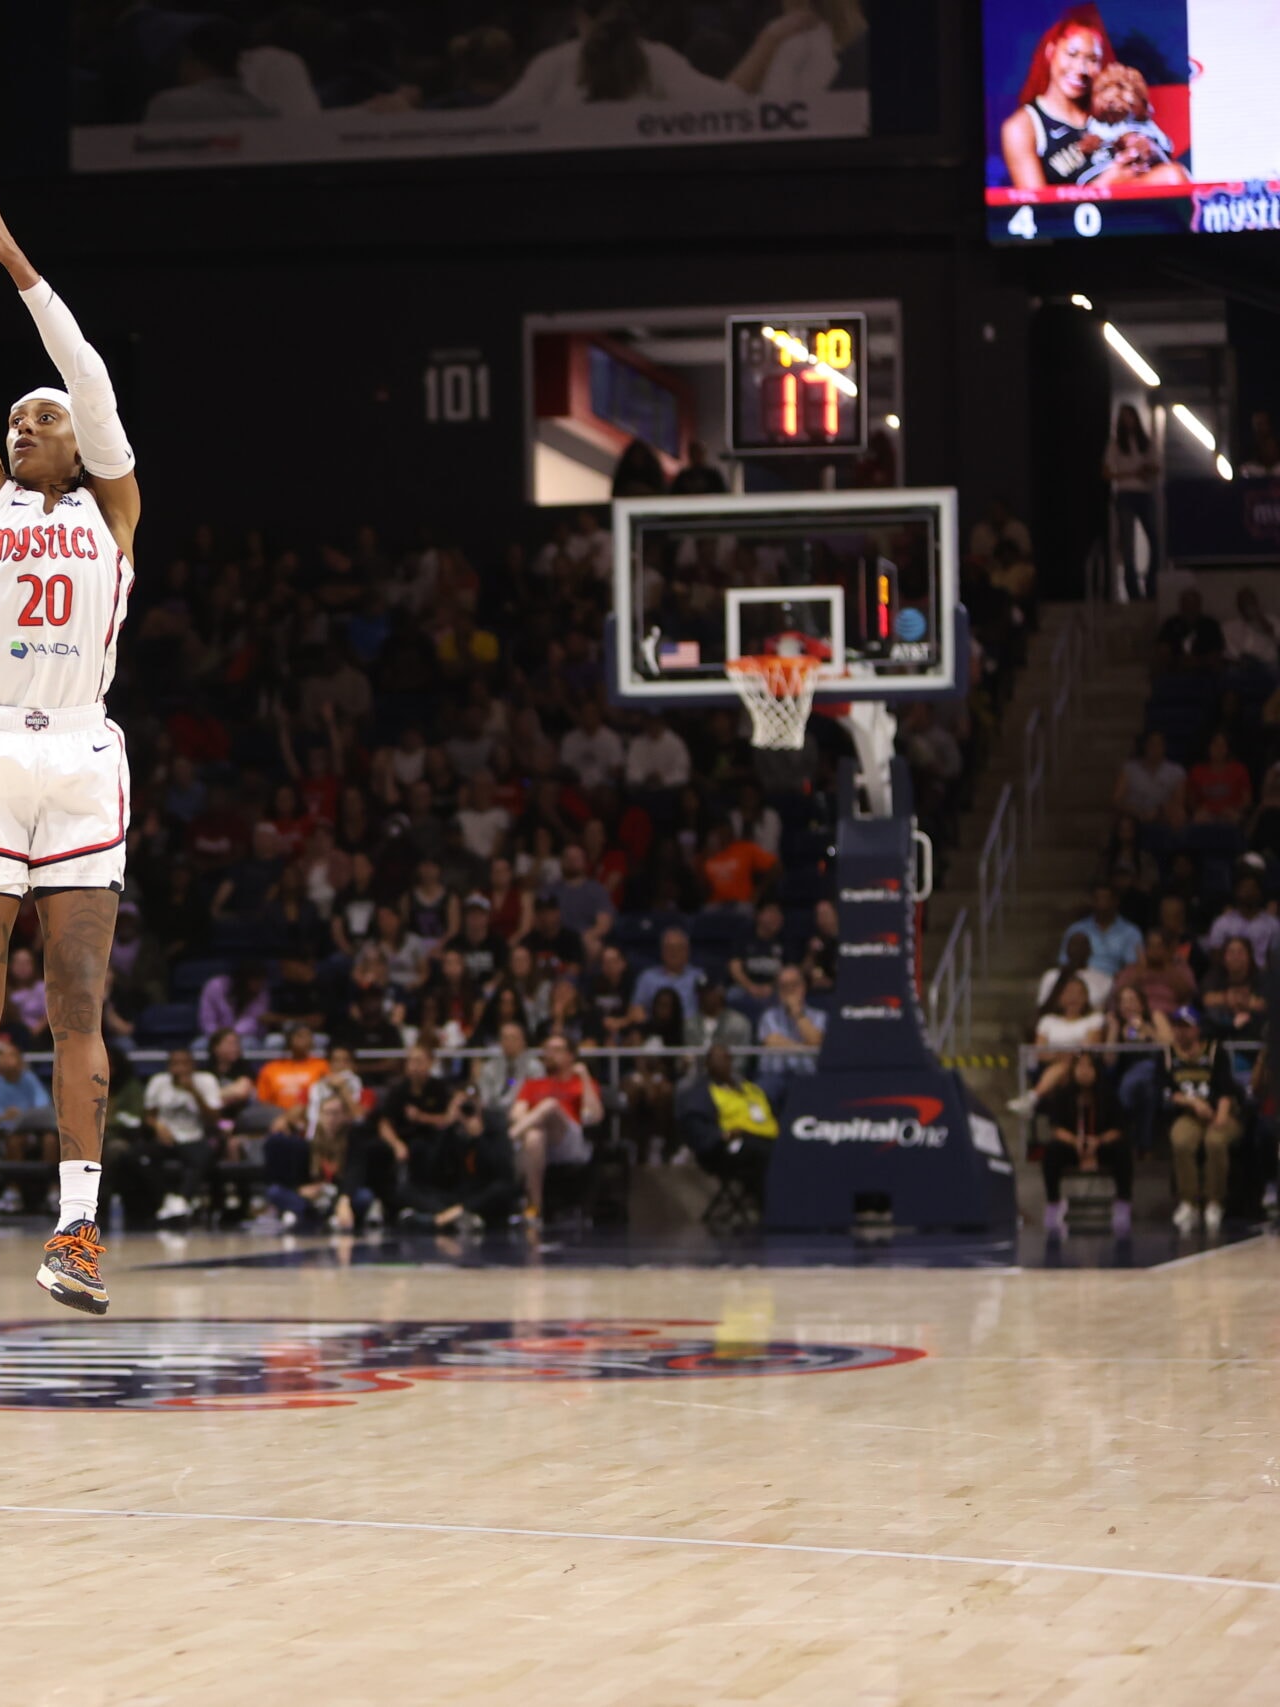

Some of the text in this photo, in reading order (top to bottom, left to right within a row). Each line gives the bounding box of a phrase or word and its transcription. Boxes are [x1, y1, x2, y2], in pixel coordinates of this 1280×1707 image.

[636, 101, 809, 137] events DC
[1008, 203, 1102, 239] 4 0
[424, 363, 490, 422] 101
[782, 369, 838, 436] 17
[17, 574, 73, 627] 20
[890, 643, 929, 661] AT&T
